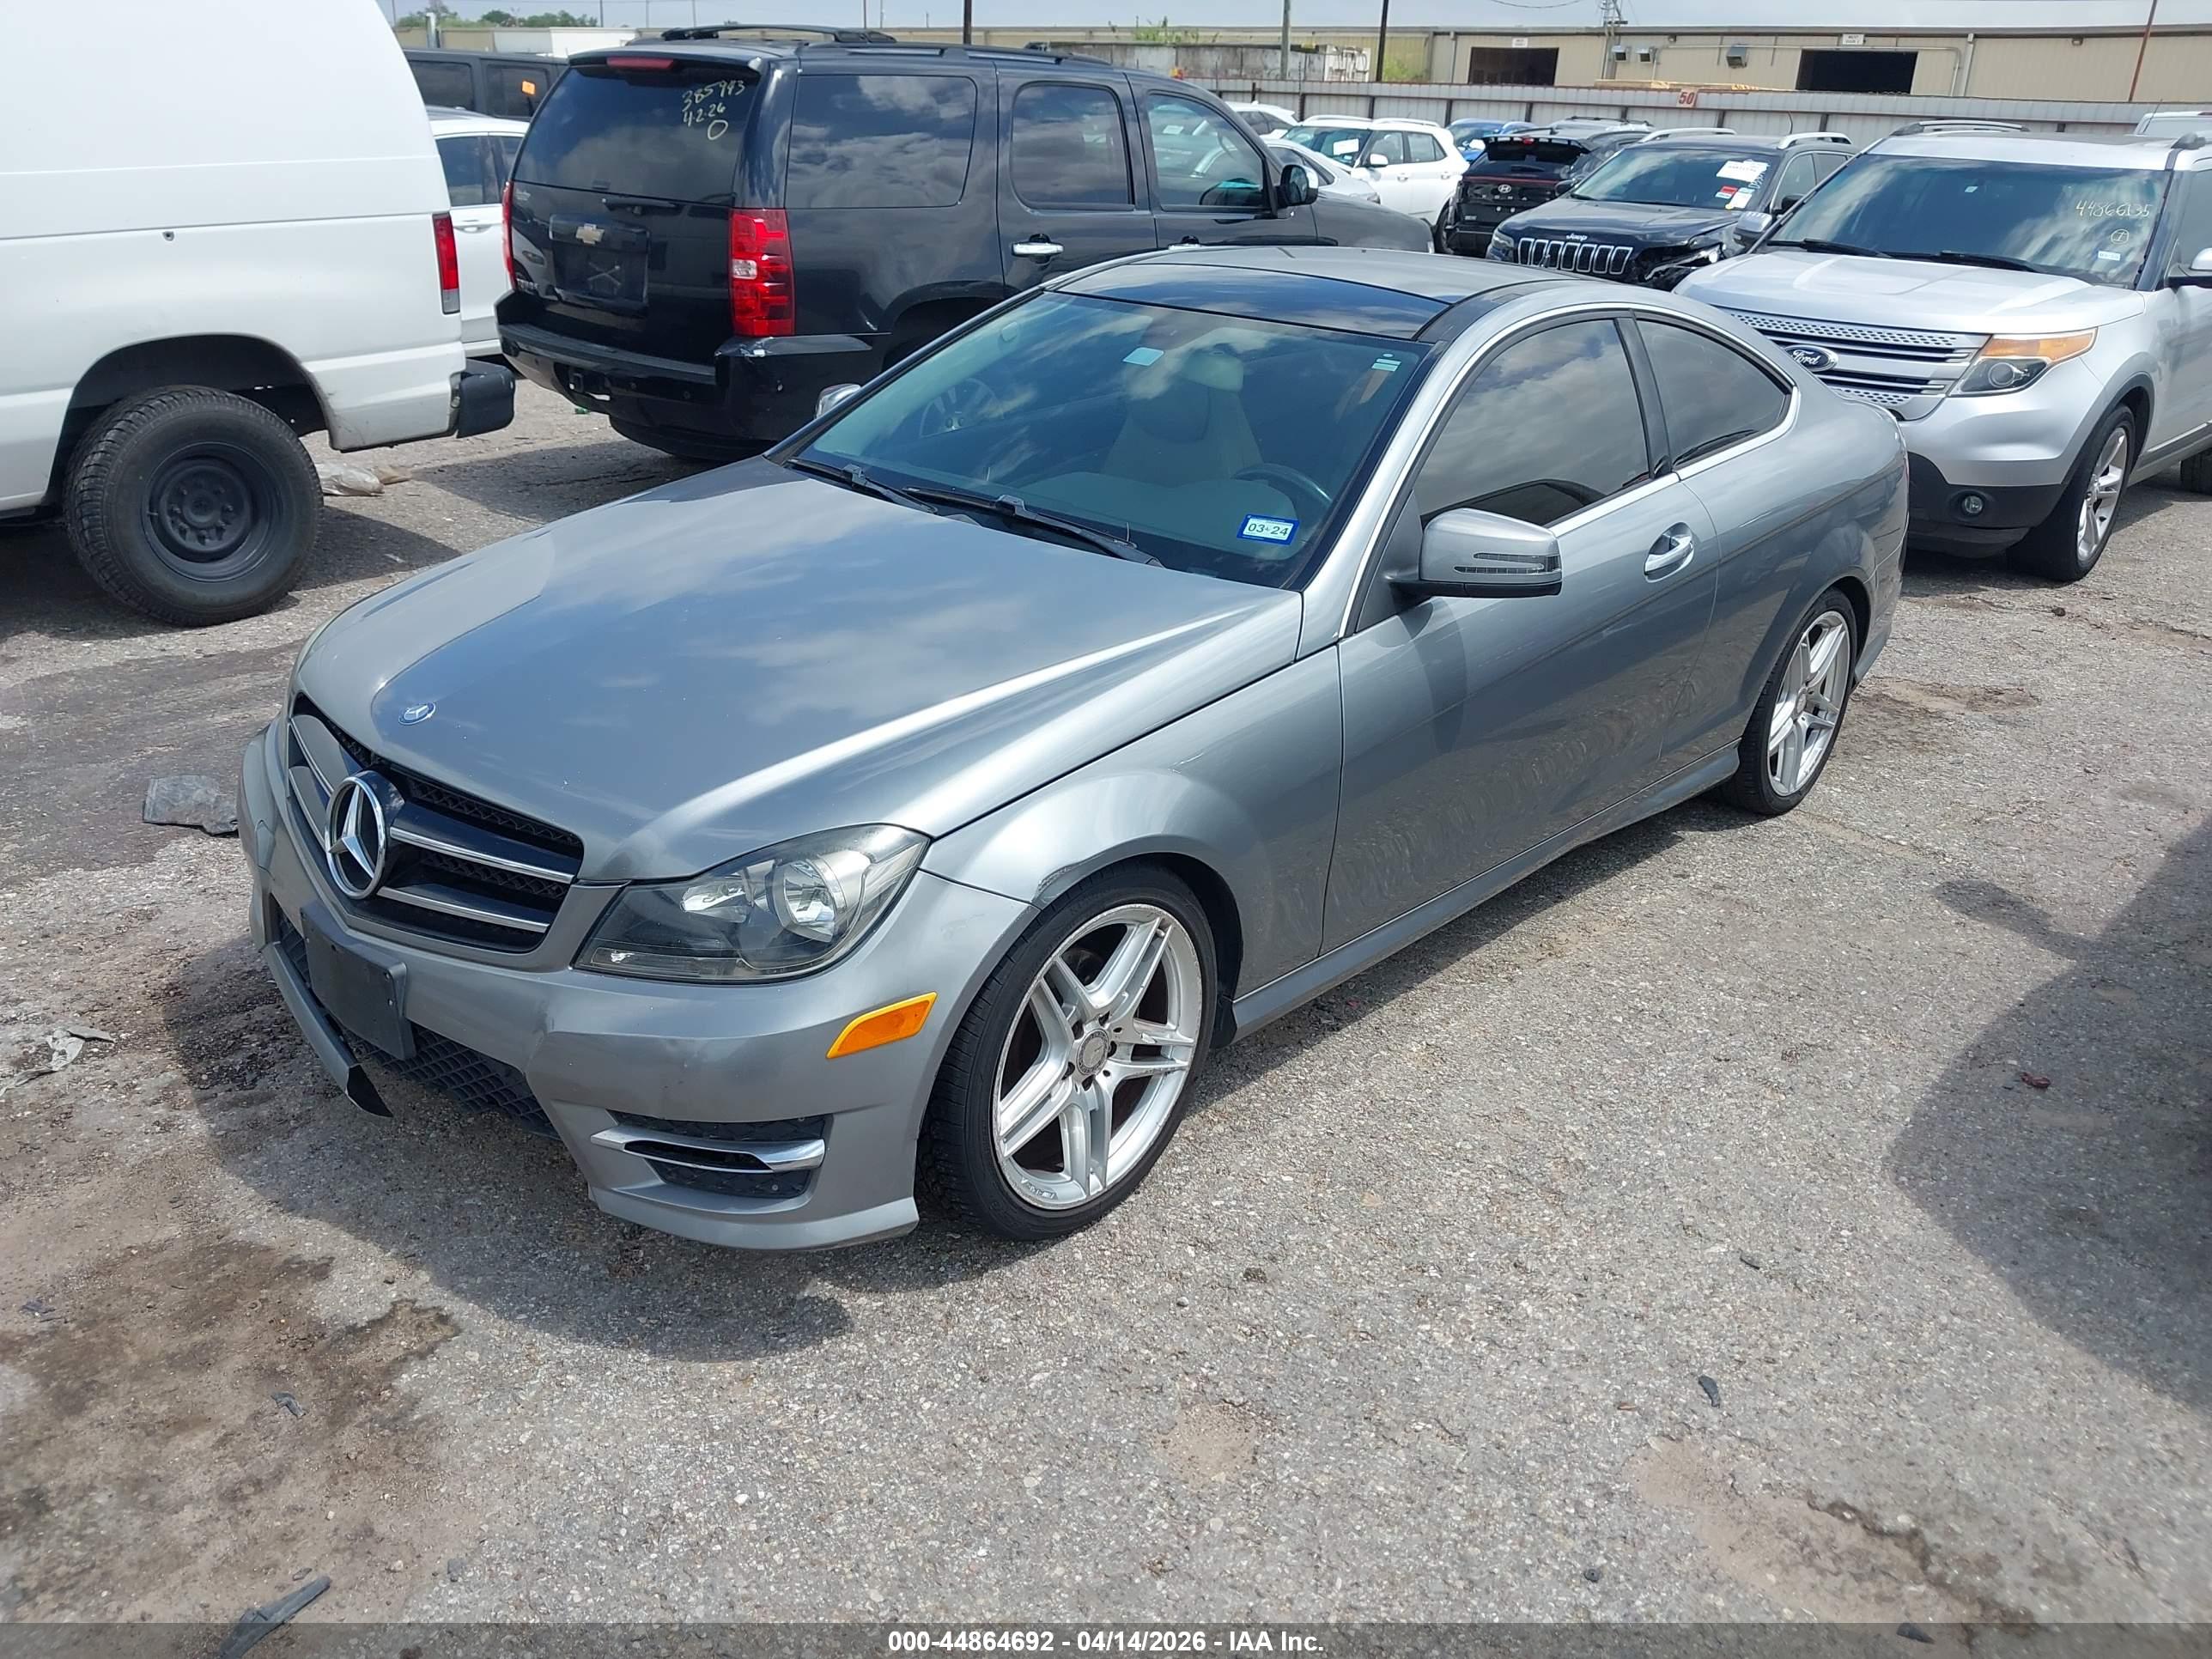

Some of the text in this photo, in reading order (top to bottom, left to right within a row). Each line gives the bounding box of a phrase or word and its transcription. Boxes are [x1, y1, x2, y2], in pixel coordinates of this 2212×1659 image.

[1679, 92, 1695, 104] 50
[1565, 233, 1588, 241] Jeep
[1792, 349, 1821, 365] Ford
